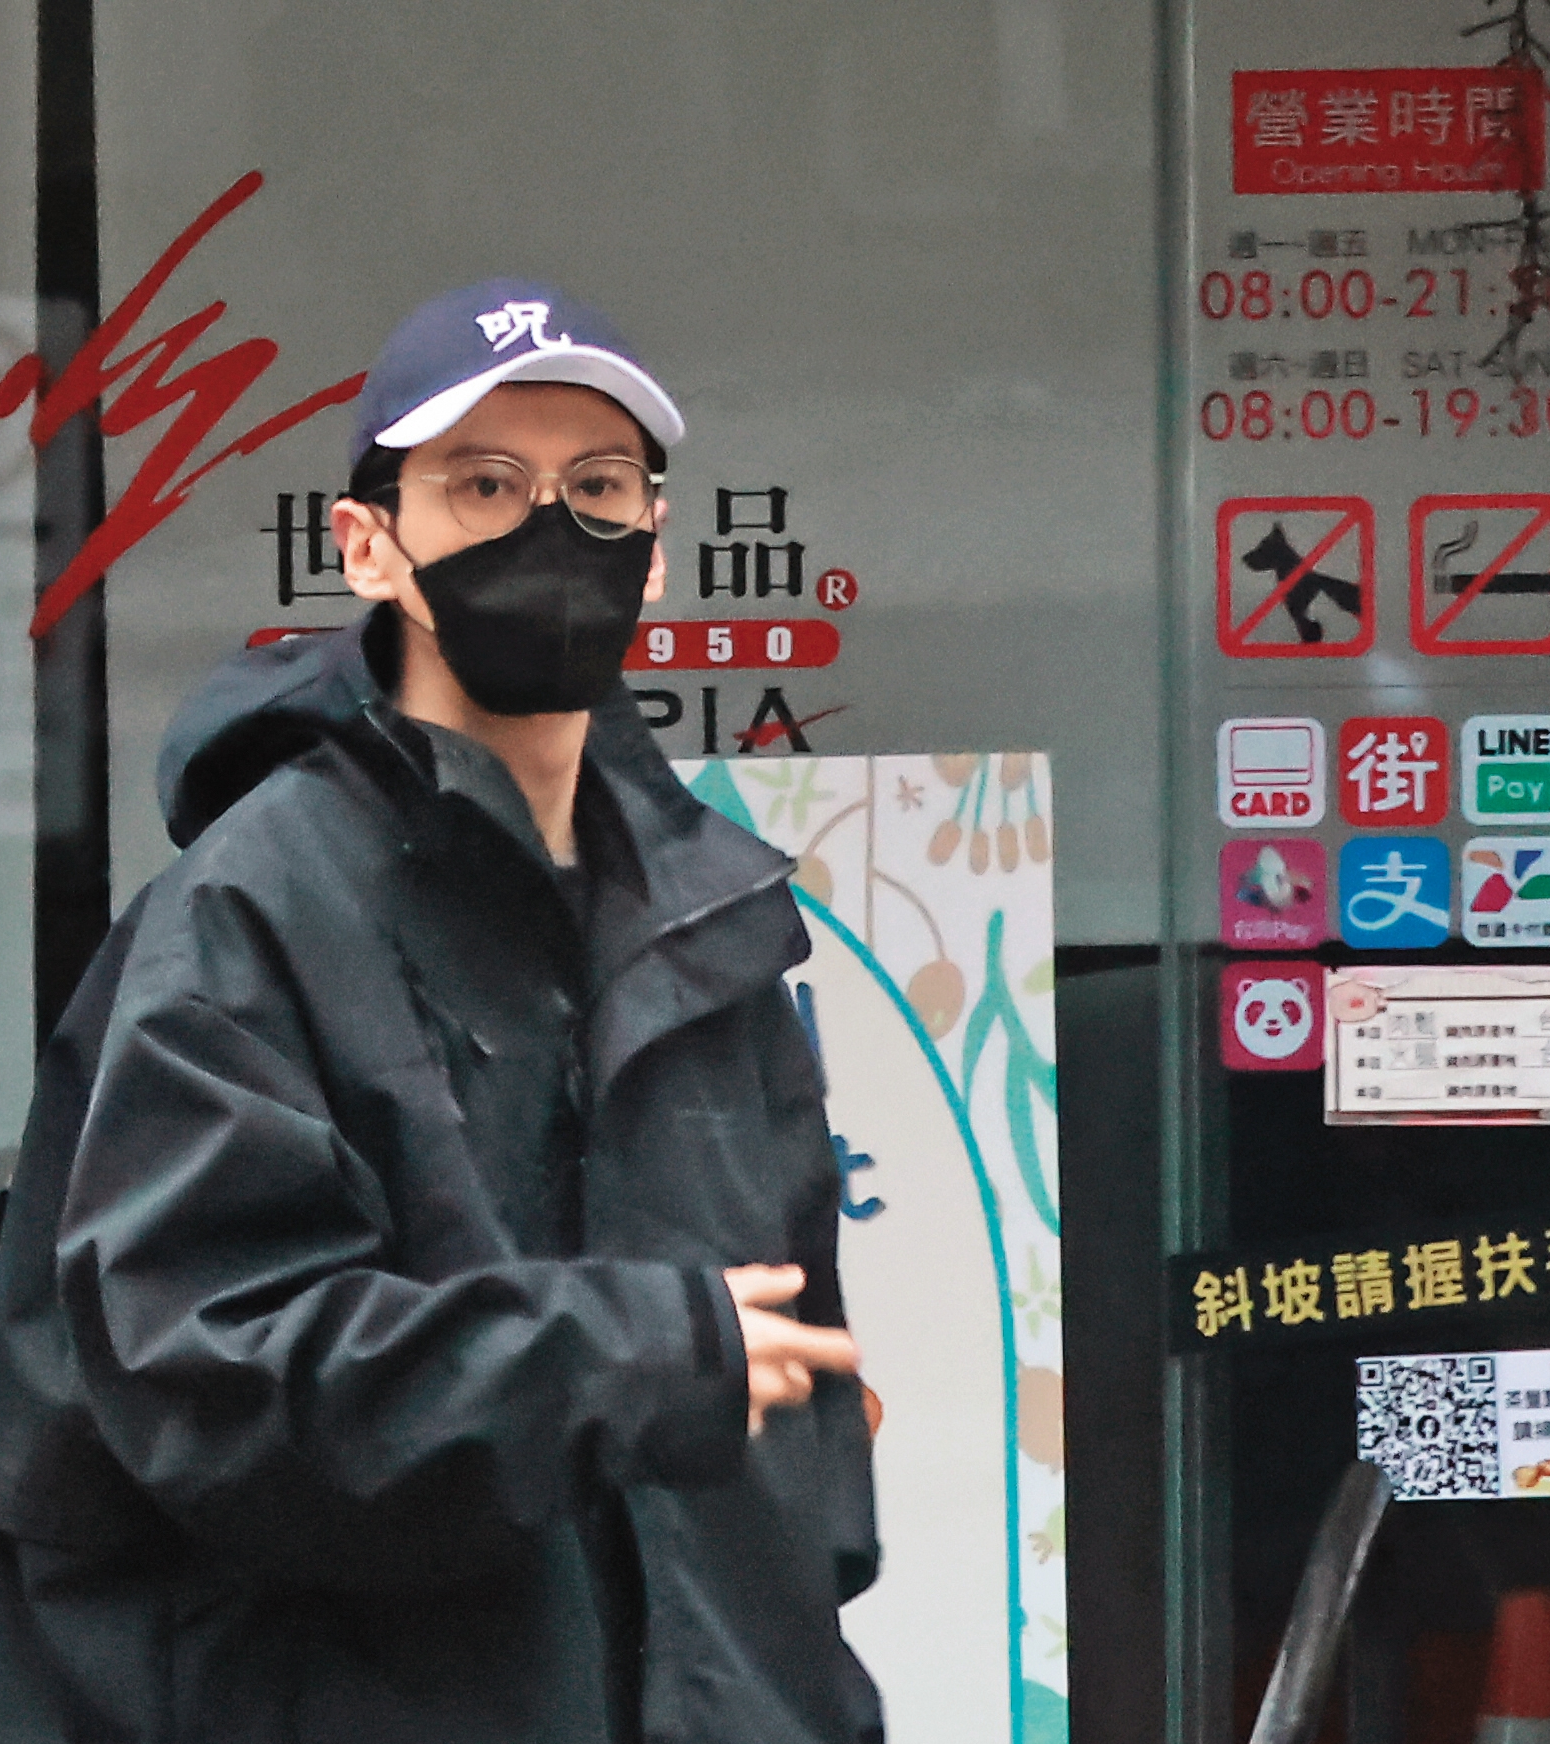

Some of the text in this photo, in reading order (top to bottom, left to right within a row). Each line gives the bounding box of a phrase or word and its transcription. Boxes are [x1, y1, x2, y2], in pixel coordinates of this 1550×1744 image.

[1478, 729, 1550, 756] LINE
[1488, 775, 1544, 802] Pay
[1231, 791, 1311, 817] CARD
